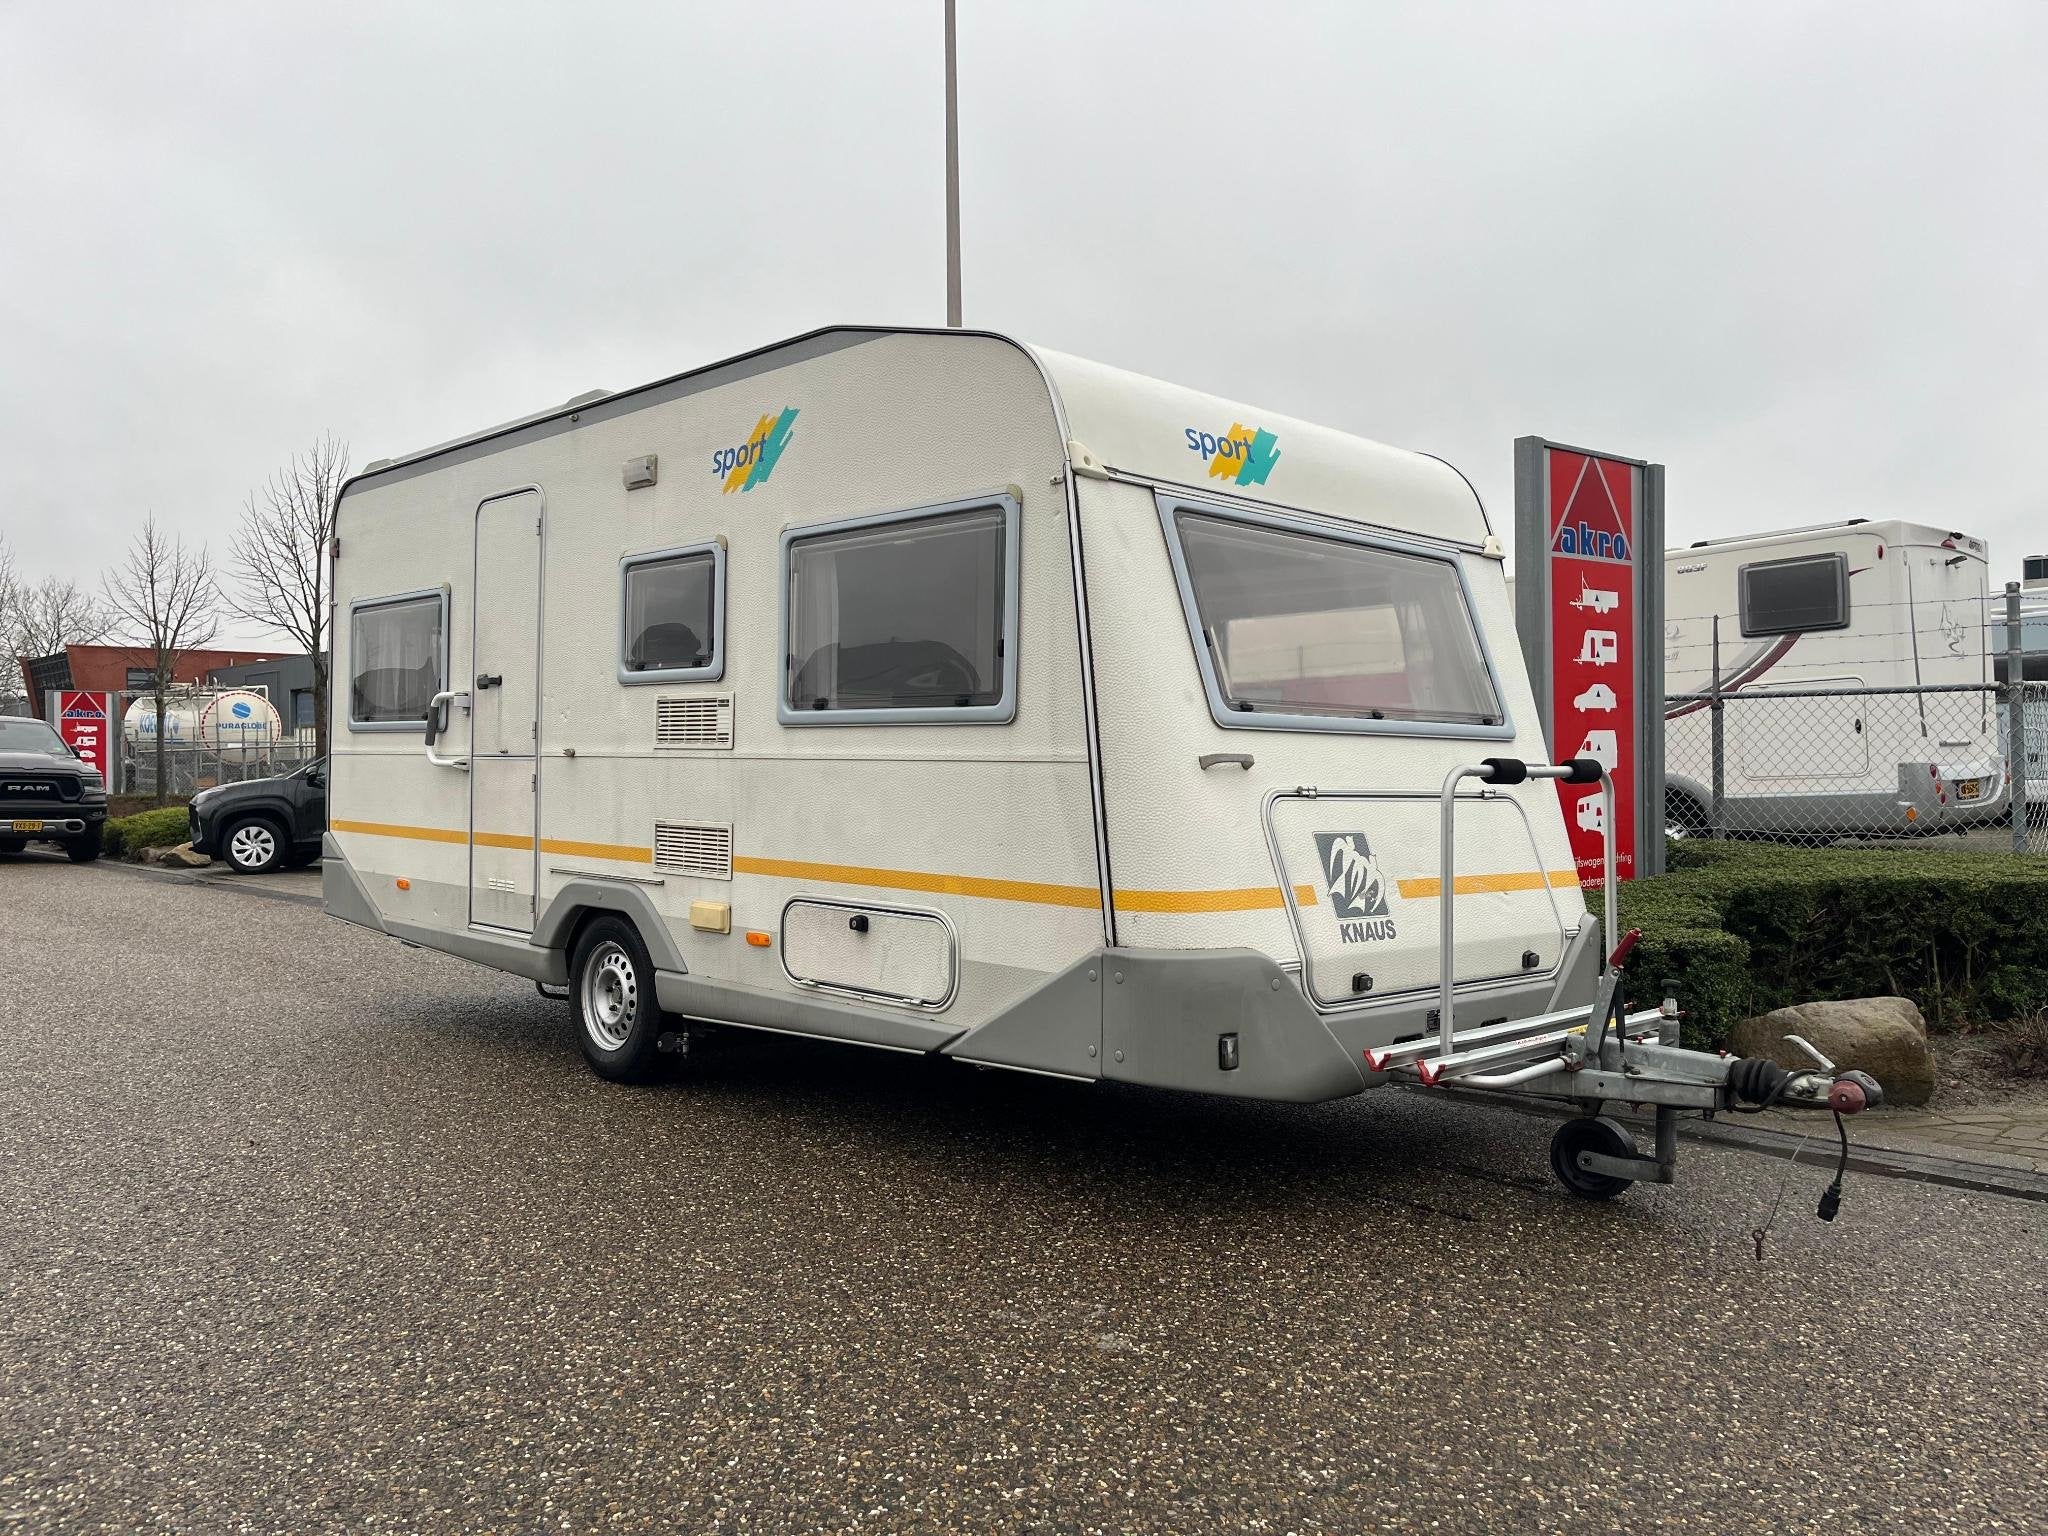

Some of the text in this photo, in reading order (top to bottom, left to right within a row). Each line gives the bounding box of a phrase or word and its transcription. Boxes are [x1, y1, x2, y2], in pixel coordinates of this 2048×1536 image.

[712, 432, 767, 480] sport
[1185, 428, 1255, 464] sport
[1560, 520, 1627, 560] akro
[66, 708, 103, 719] akro
[1339, 919, 1397, 944] KNAUS
